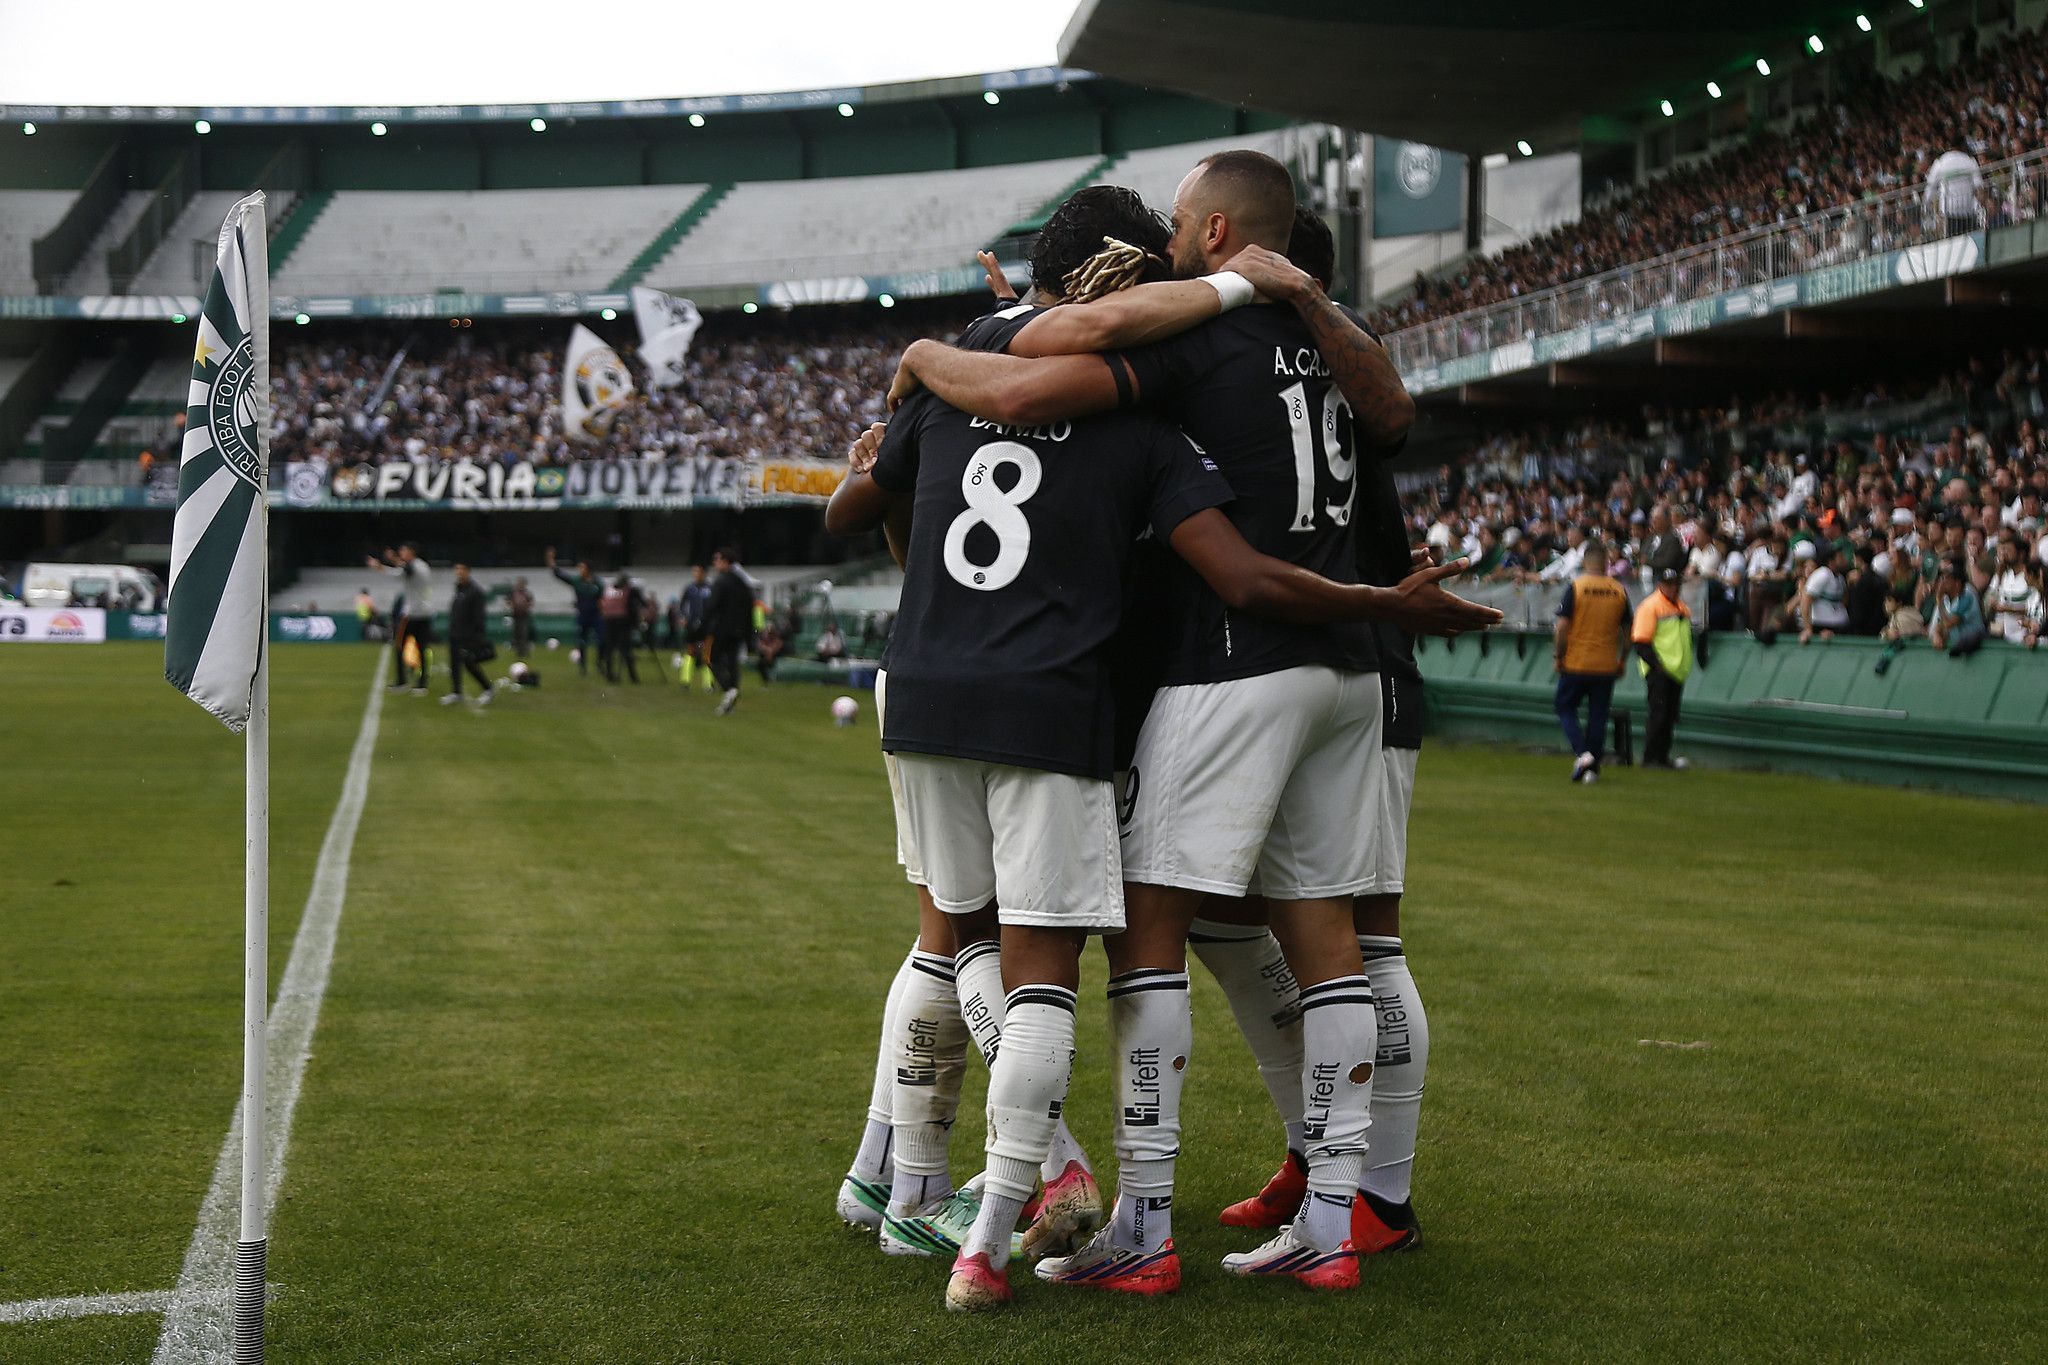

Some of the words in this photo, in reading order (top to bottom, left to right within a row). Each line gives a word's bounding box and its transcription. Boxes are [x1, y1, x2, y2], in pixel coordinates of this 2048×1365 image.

[216, 357, 244, 407] FOOT
[216, 414, 261, 481] ORITIBA
[971, 462, 987, 486] Oxy
[1278, 381, 1357, 532] 19
[943, 440, 1042, 592] 8
[905, 1017, 939, 1069] Lifefit
[964, 992, 1001, 1046] Lifefit
[1130, 1047, 1160, 1107] Lifefit
[1307, 1062, 1341, 1122] Lifefit
[1132, 1198, 1146, 1248] EDESIGN
